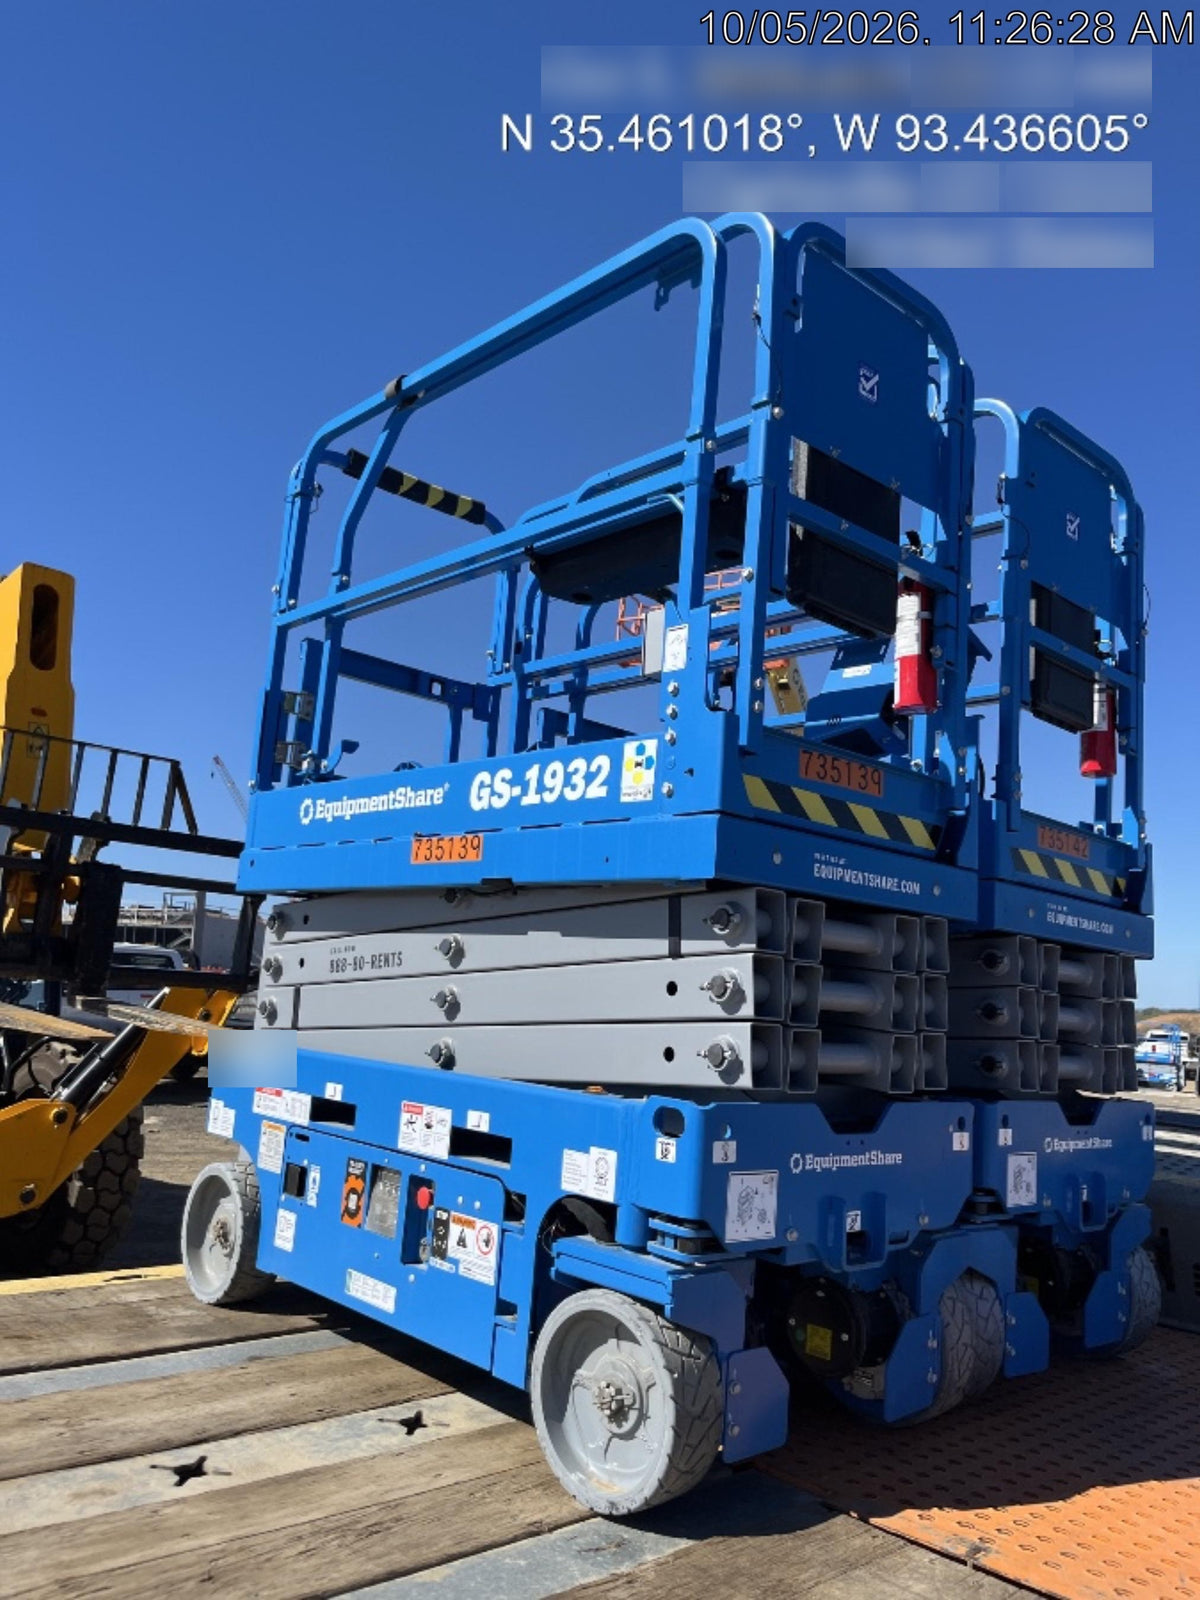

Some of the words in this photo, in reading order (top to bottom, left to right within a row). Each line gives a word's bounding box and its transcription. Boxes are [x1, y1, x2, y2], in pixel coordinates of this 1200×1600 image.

[469, 754, 611, 812] GS-1932
[801, 750, 881, 795] 735139
[415, 835, 481, 861] 735139
[813, 863, 921, 895] EQUIPMENTSHARE.COM
[805, 1150, 903, 1172] EquipmentShare
